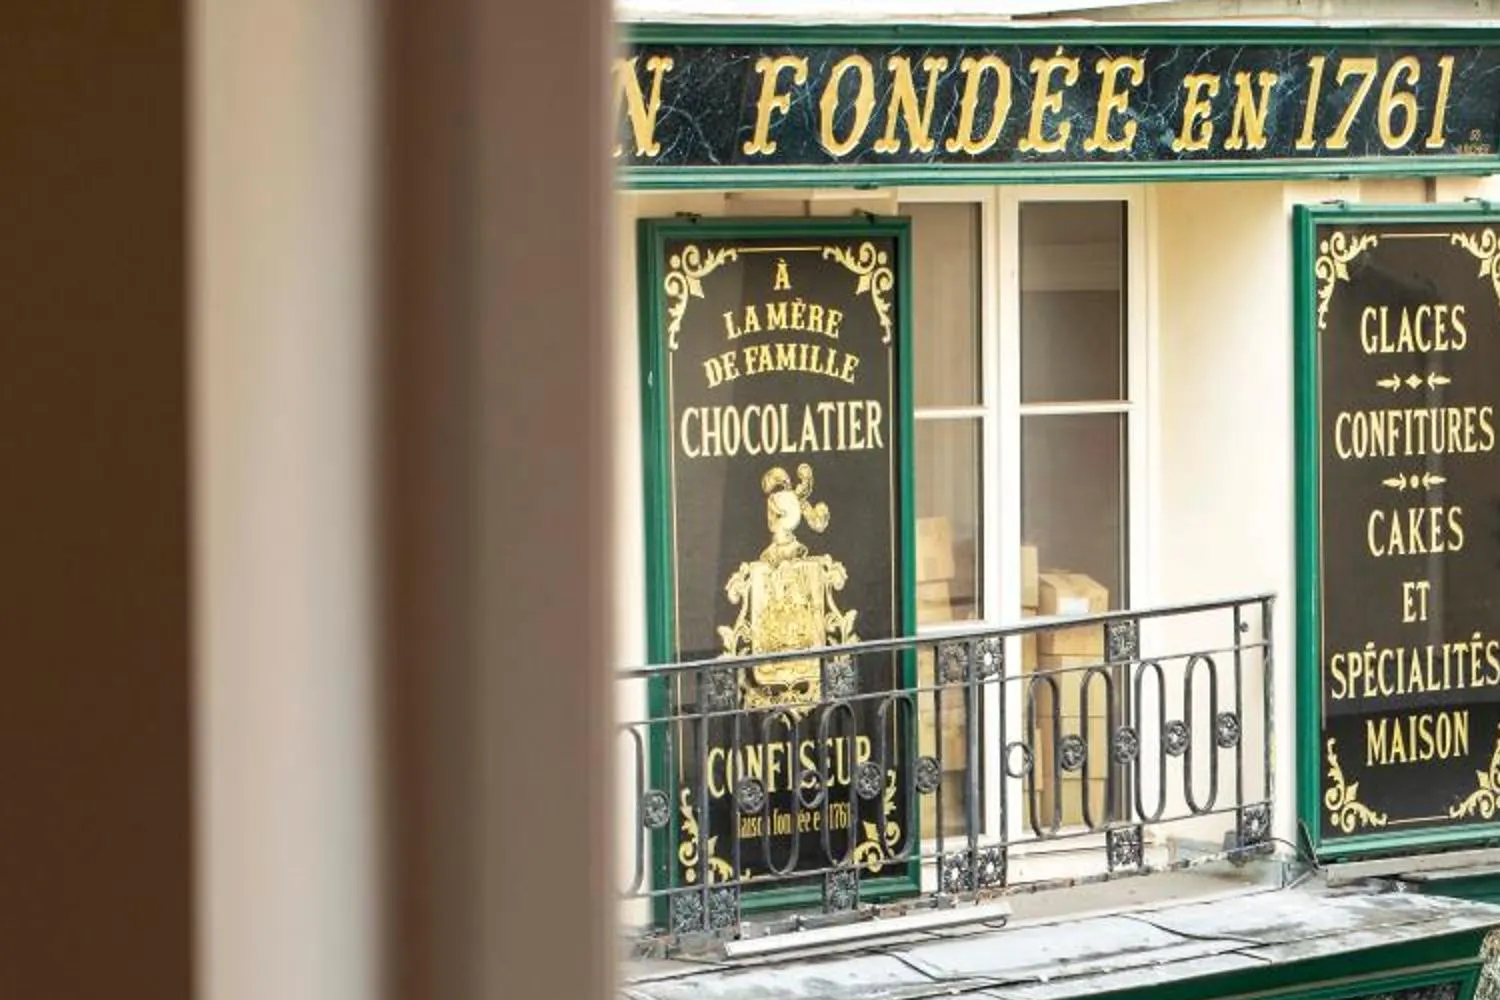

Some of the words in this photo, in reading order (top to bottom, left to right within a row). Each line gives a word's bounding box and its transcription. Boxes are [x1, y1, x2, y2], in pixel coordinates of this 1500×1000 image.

[743, 45, 1145, 157] FONDÉE
[1172, 71, 1280, 153] EN
[1295, 55, 1455, 151] 1761
[773, 257, 791, 290] À
[723, 305, 760, 340] LA
[766, 297, 843, 339] MÈRE
[1360, 304, 1467, 355] GLACES
[703, 351, 740, 388] DE
[743, 343, 860, 384] FAMILLE
[680, 400, 884, 458] CHOCOLATIER
[1335, 406, 1495, 460] CONFITURES
[1367, 506, 1465, 557] CAKES
[1402, 580, 1431, 623] ET
[1366, 709, 1470, 767] MAISON
